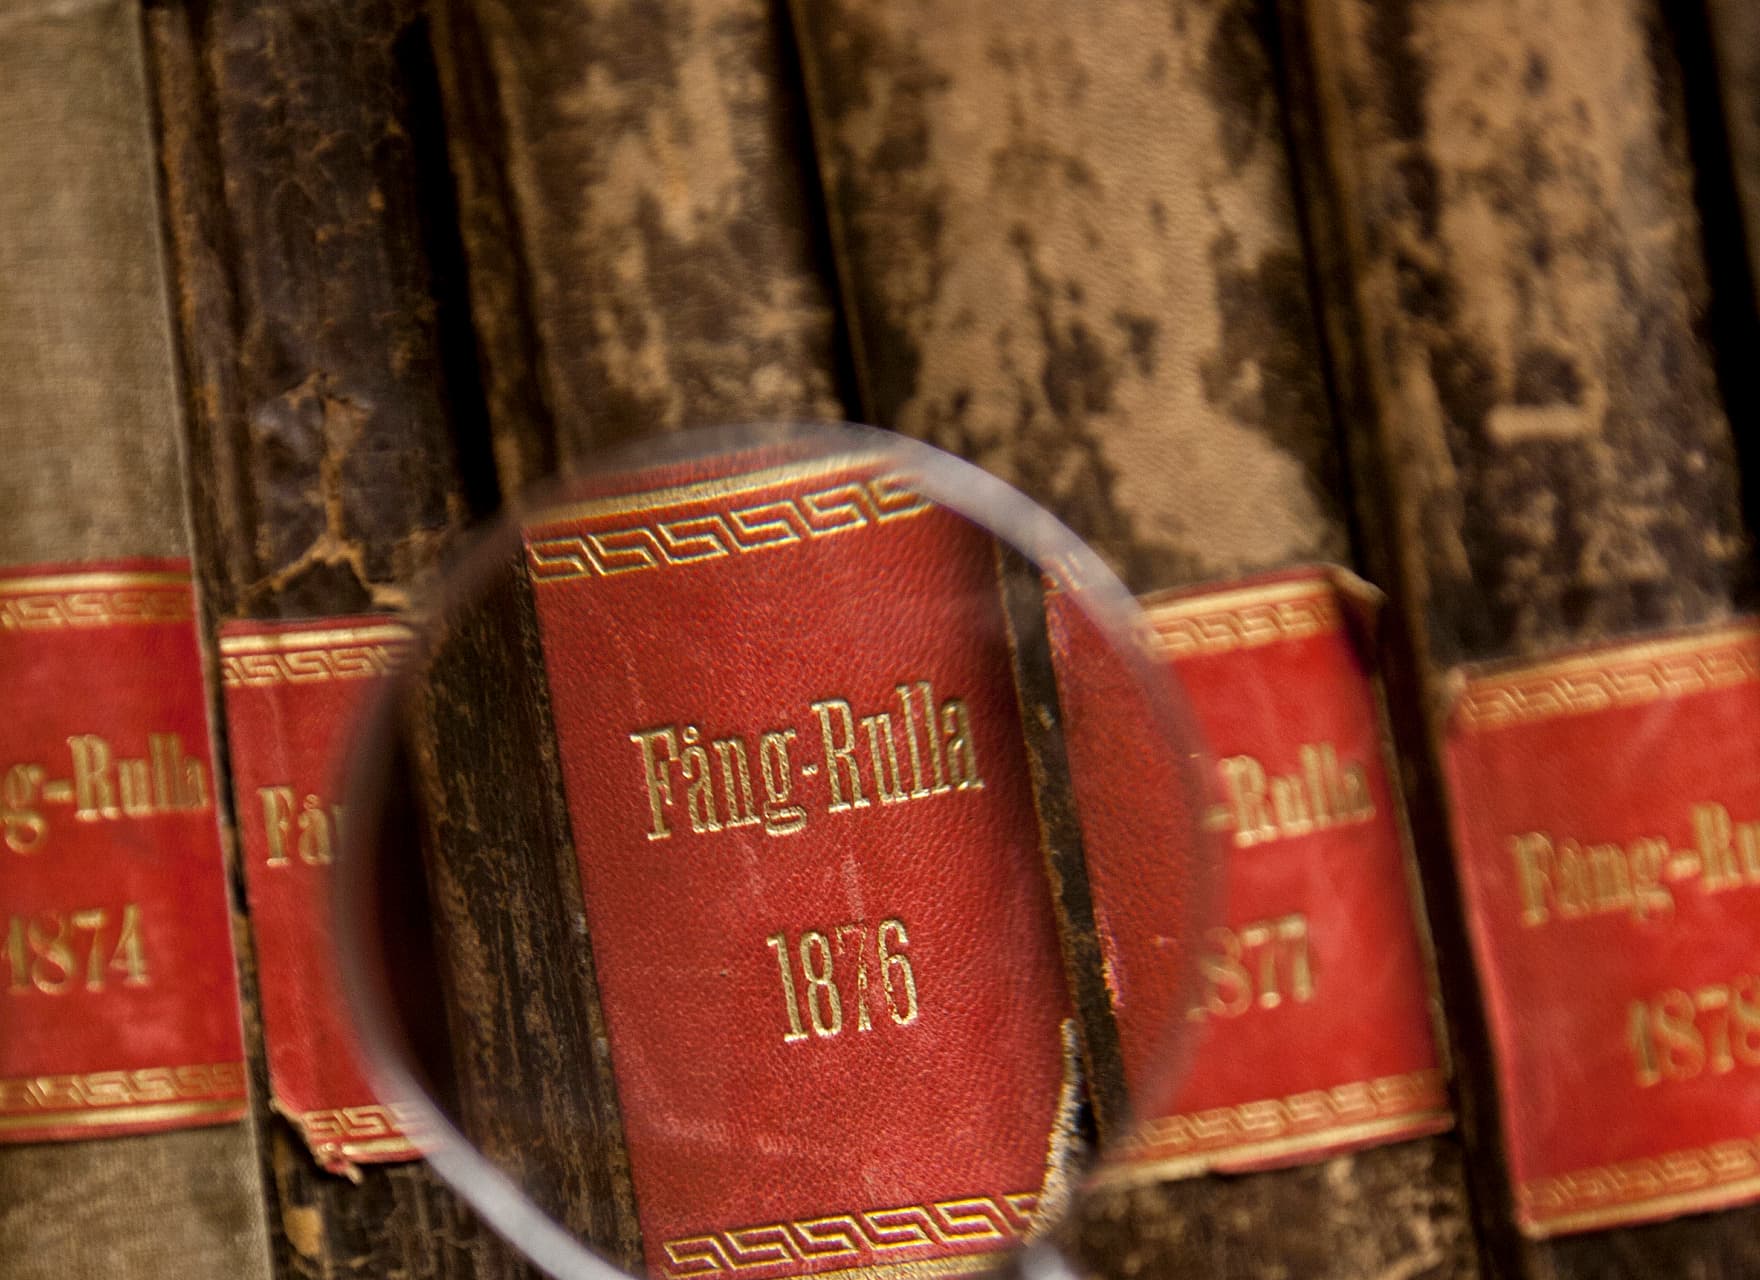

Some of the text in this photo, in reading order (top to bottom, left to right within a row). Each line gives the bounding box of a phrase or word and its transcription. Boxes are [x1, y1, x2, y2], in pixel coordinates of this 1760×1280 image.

[630, 681, 984, 841] Fång-Rulla
[1203, 741, 1376, 848] -Rulla
[2, 902, 150, 995] 1874
[766, 919, 918, 1042] 1876
